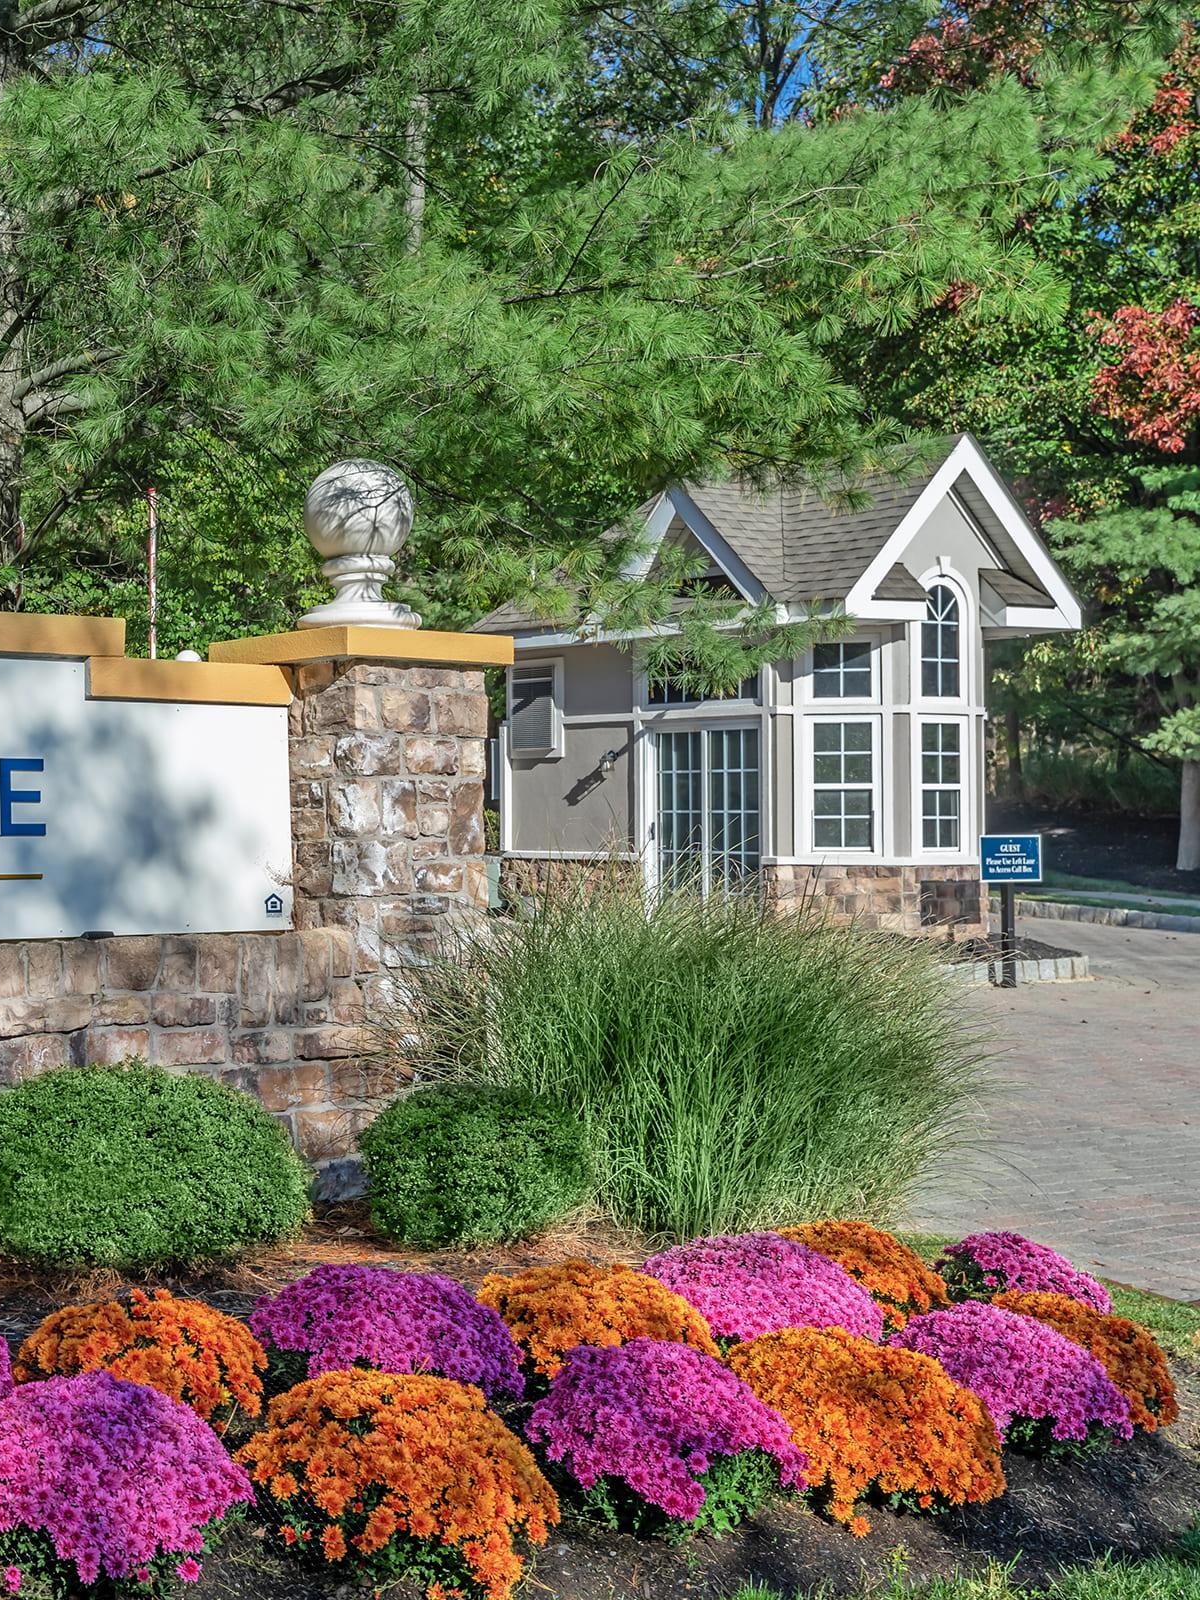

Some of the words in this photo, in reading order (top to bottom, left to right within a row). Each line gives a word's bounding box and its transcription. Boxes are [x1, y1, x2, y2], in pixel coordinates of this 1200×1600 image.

[1000, 844, 1021, 852] GUEST
[986, 857, 1001, 865] Please
[1002, 857, 1011, 865] Use
[1012, 857, 1022, 865] Left
[1023, 857, 1035, 865] Lane
